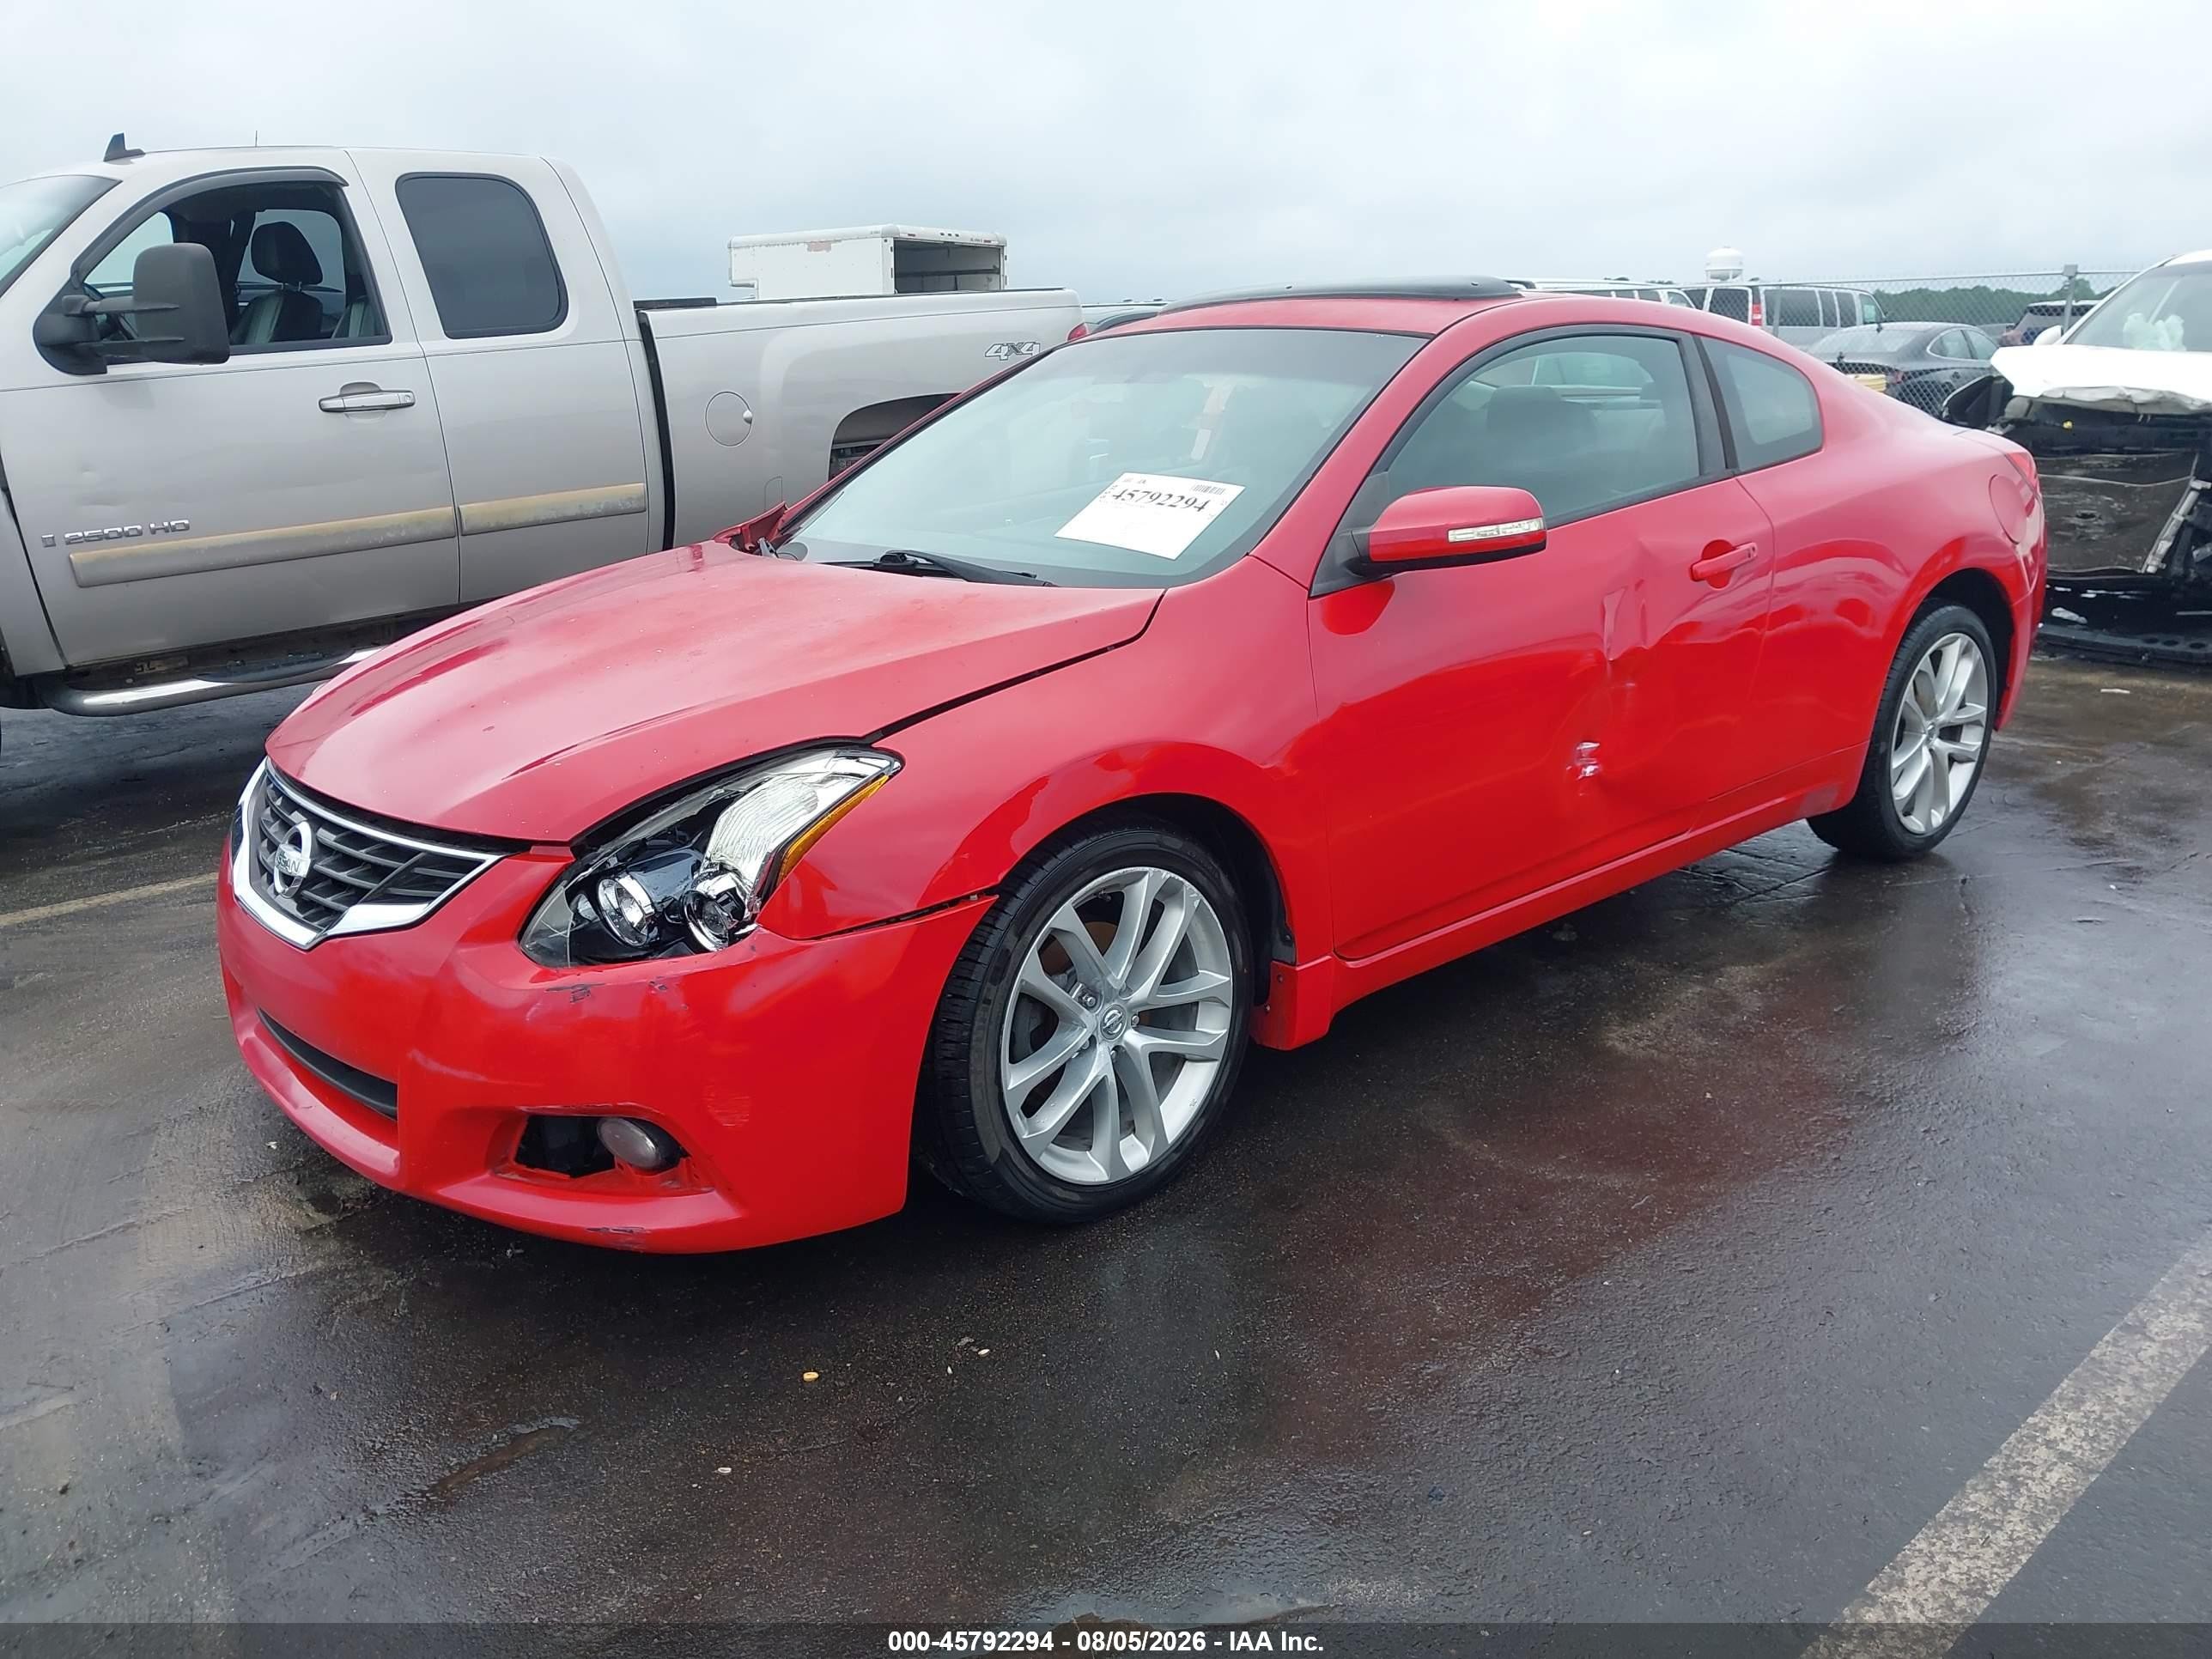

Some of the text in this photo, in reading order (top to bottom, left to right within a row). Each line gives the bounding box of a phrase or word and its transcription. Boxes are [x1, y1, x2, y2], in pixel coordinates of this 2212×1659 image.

[1112, 488, 1212, 513] 45792294
[64, 520, 190, 545] 2500 HD
